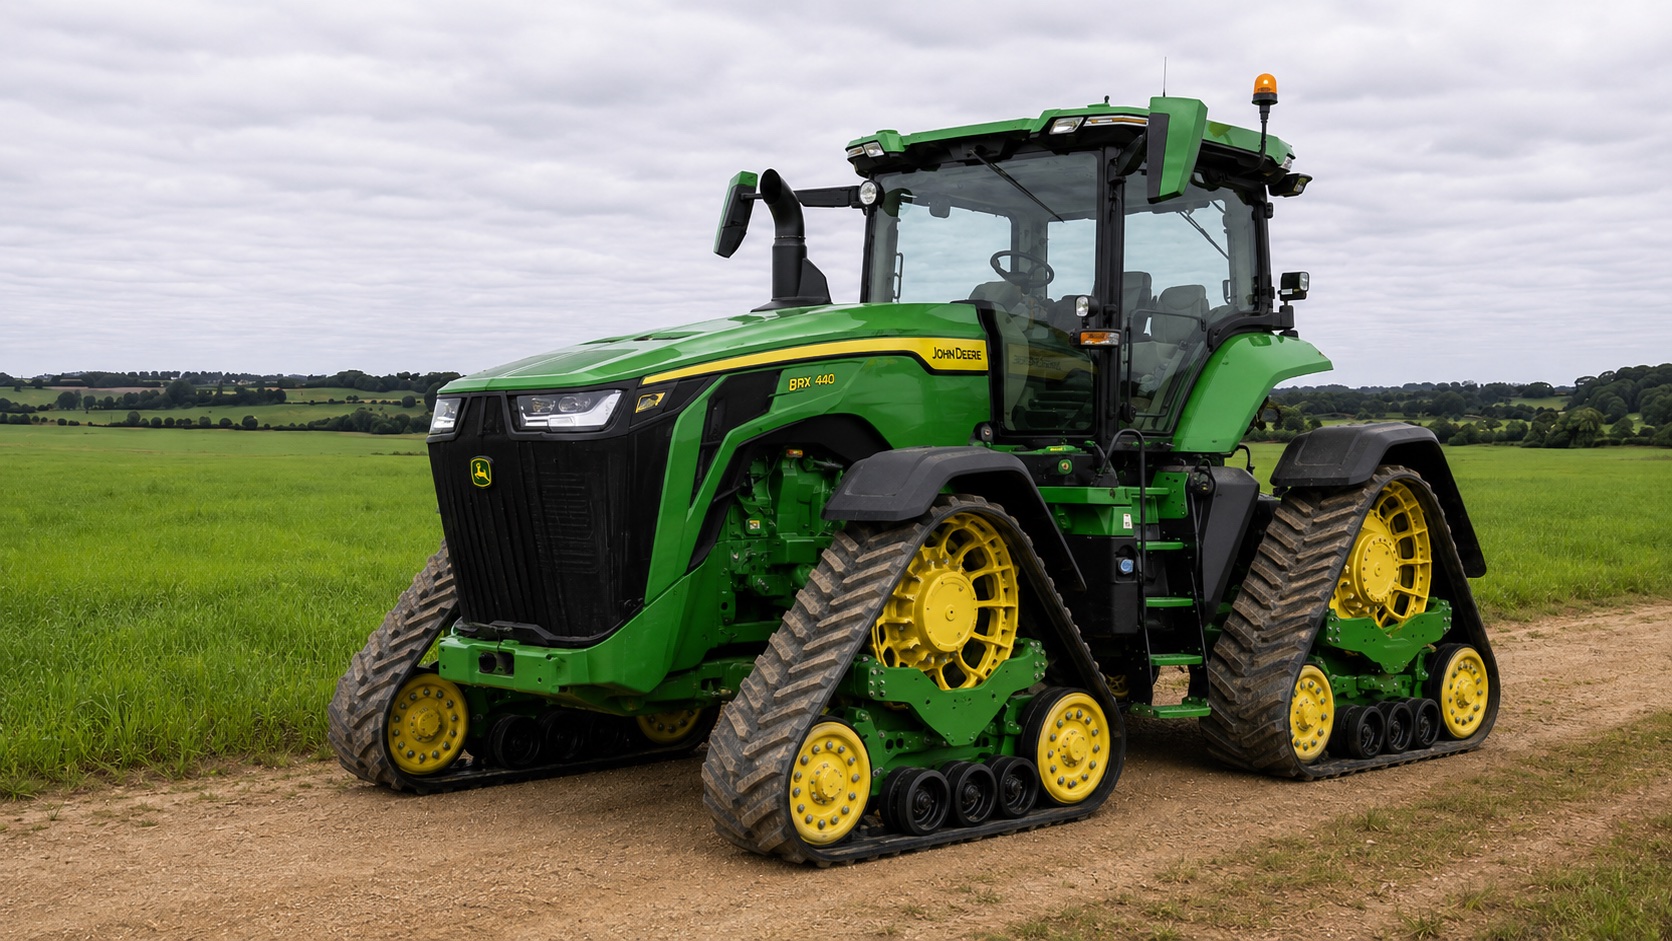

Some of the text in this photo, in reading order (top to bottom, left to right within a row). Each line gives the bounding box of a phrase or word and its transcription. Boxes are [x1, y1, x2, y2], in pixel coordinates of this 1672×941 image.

[932, 346, 981, 360] JOHN DEERE
[789, 373, 835, 391] BRX 440
